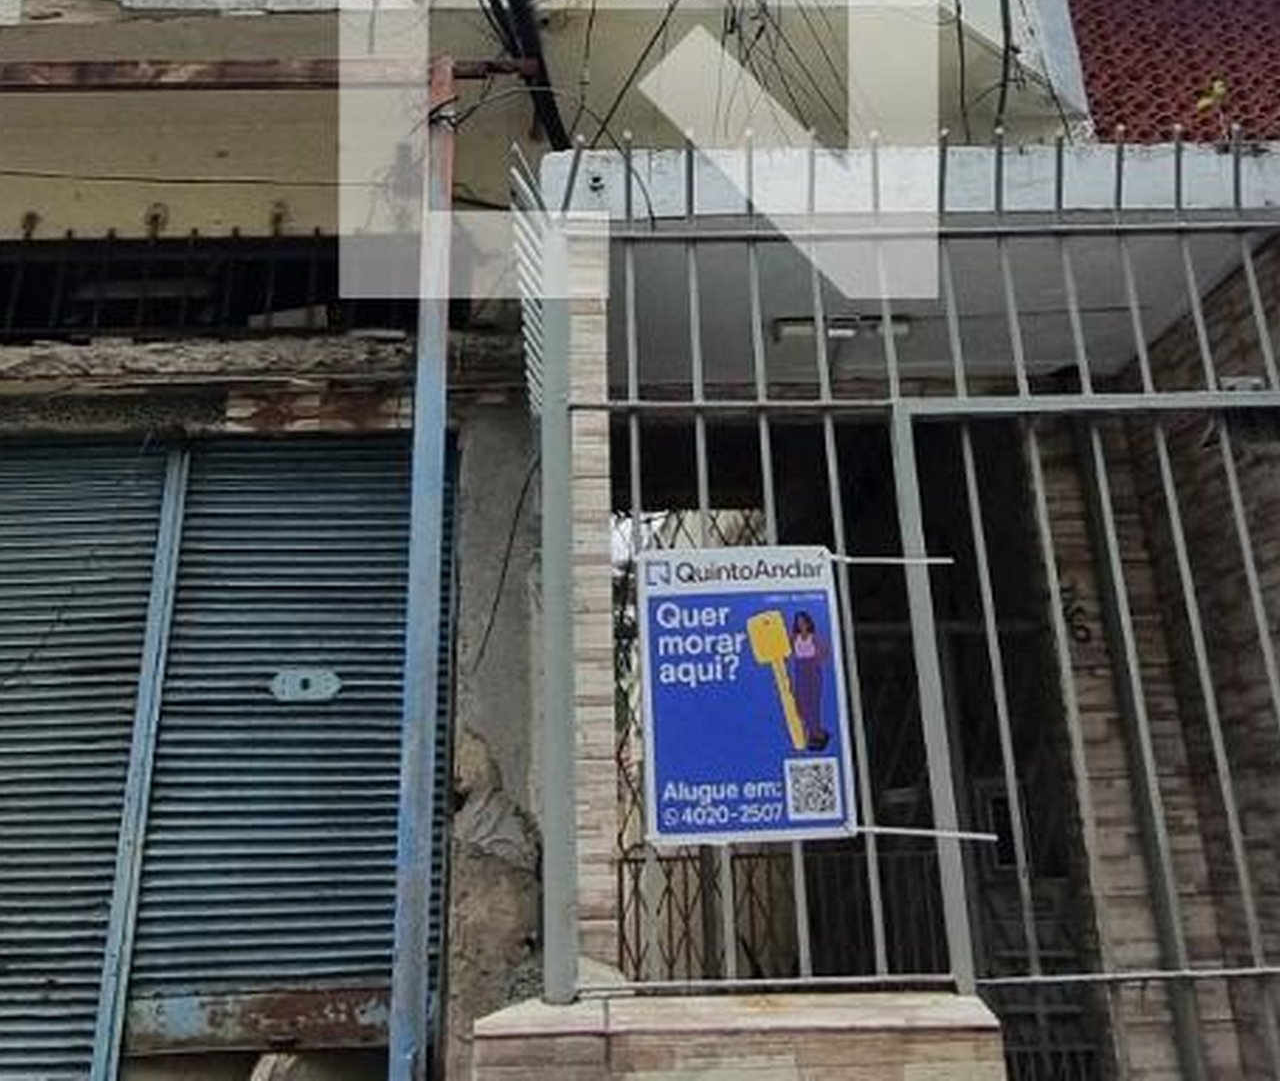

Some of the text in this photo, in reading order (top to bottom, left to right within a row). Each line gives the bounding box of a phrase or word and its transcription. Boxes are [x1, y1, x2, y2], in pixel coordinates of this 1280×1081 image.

[675, 559, 824, 584] QuintoAndar
[656, 603, 730, 628] Quer
[658, 632, 746, 656] morar
[659, 655, 739, 688] aqui?
[663, 781, 783, 806] Alugue em:
[681, 803, 783, 825] 4020-2507
